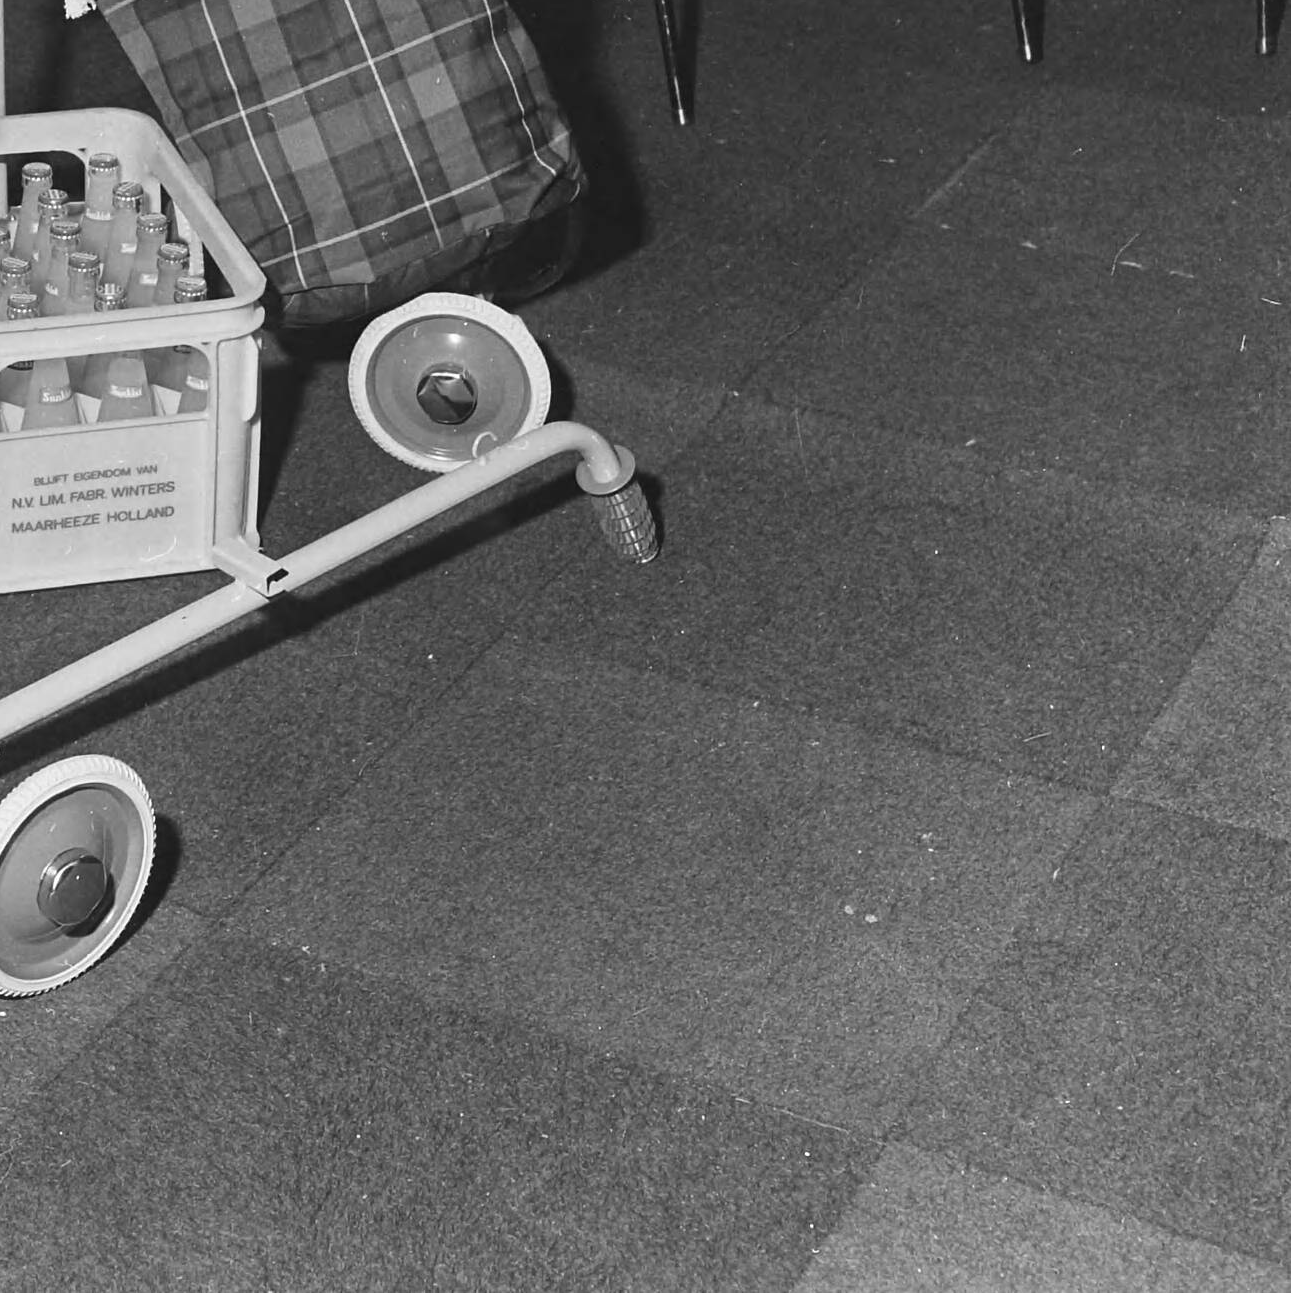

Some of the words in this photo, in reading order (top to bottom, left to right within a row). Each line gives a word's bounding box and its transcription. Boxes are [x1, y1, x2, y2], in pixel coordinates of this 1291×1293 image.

[74, 467, 131, 482] EIGENDOM
[136, 464, 158, 474] VAN
[70, 490, 107, 503] FABR.
[111, 481, 175, 498] WINTERS
[11, 513, 100, 534] MAARHEEZE
[107, 505, 175, 523] HOLLAND
